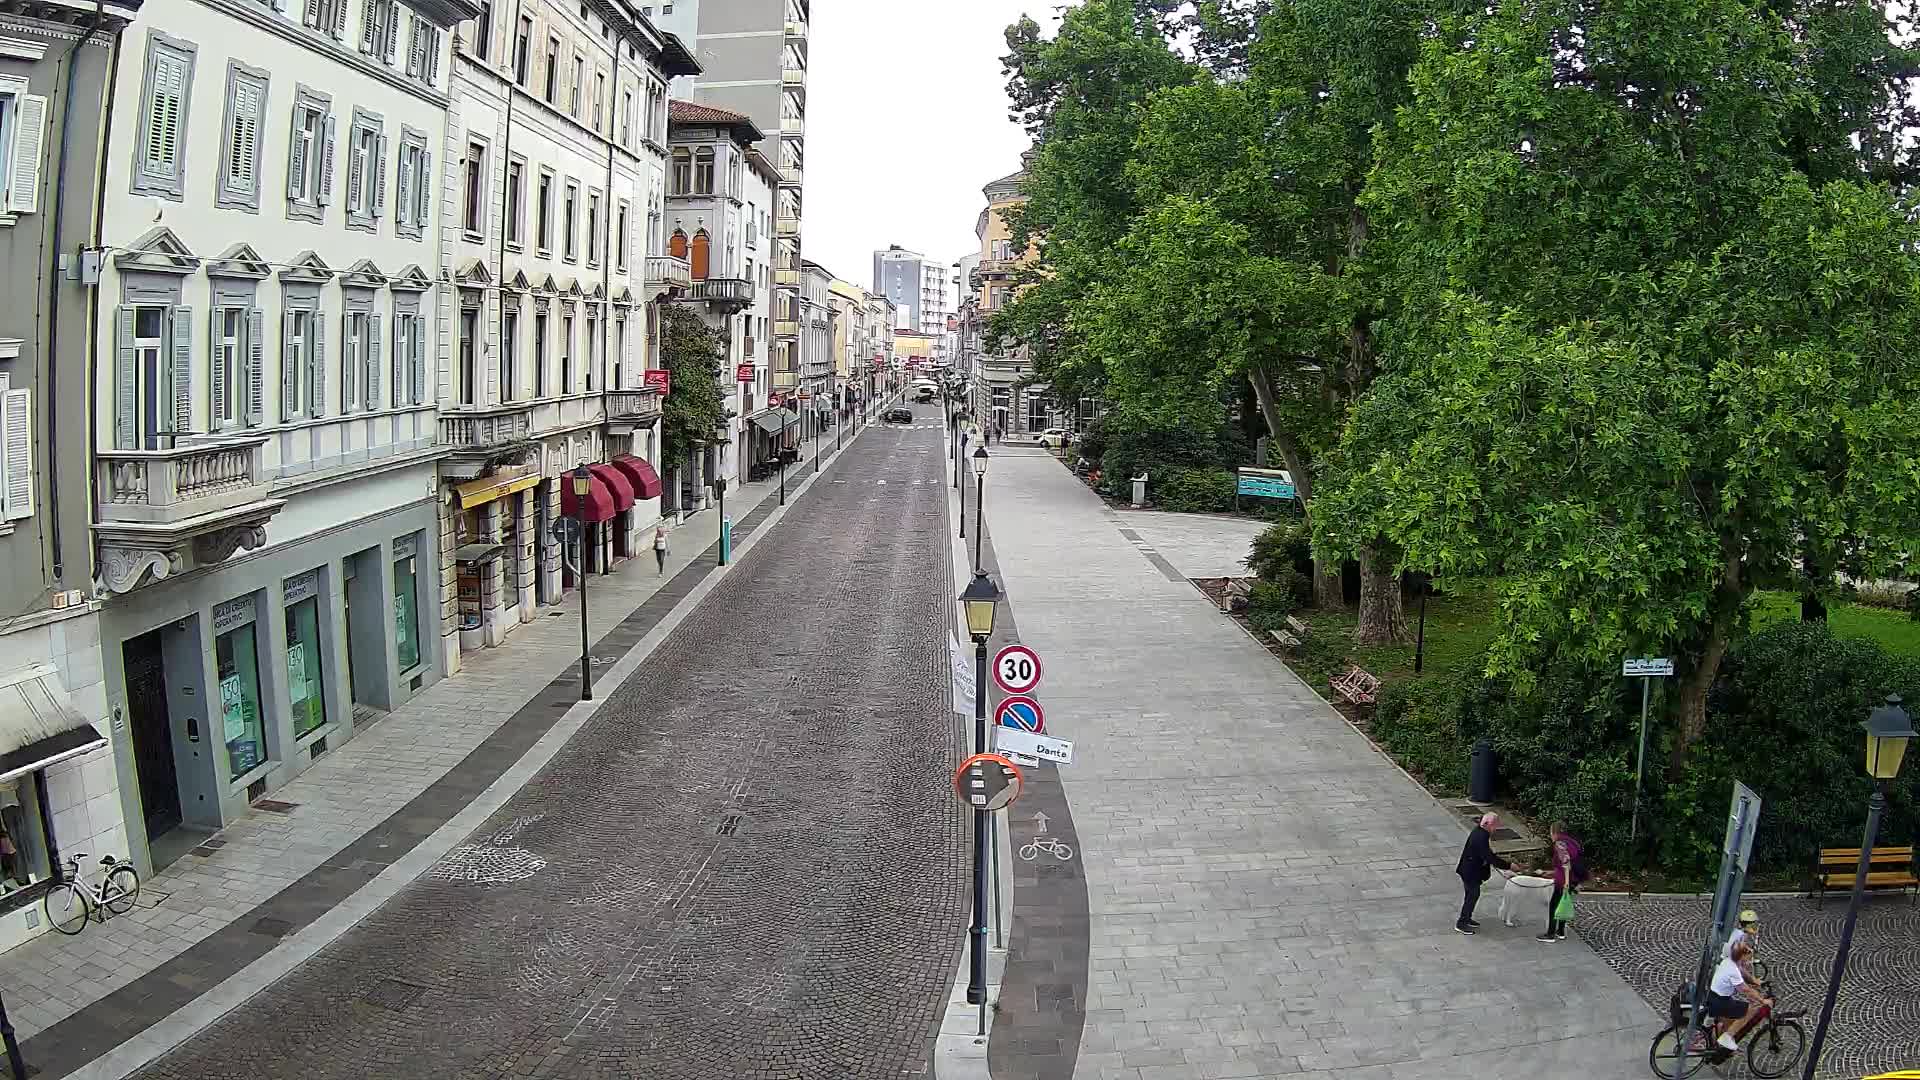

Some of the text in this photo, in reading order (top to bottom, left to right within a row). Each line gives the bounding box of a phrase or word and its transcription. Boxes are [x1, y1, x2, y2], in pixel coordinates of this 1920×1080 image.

[1004, 658, 1032, 681] 30
[221, 679, 240, 701] 130
[1036, 744, 1068, 758] Dante
